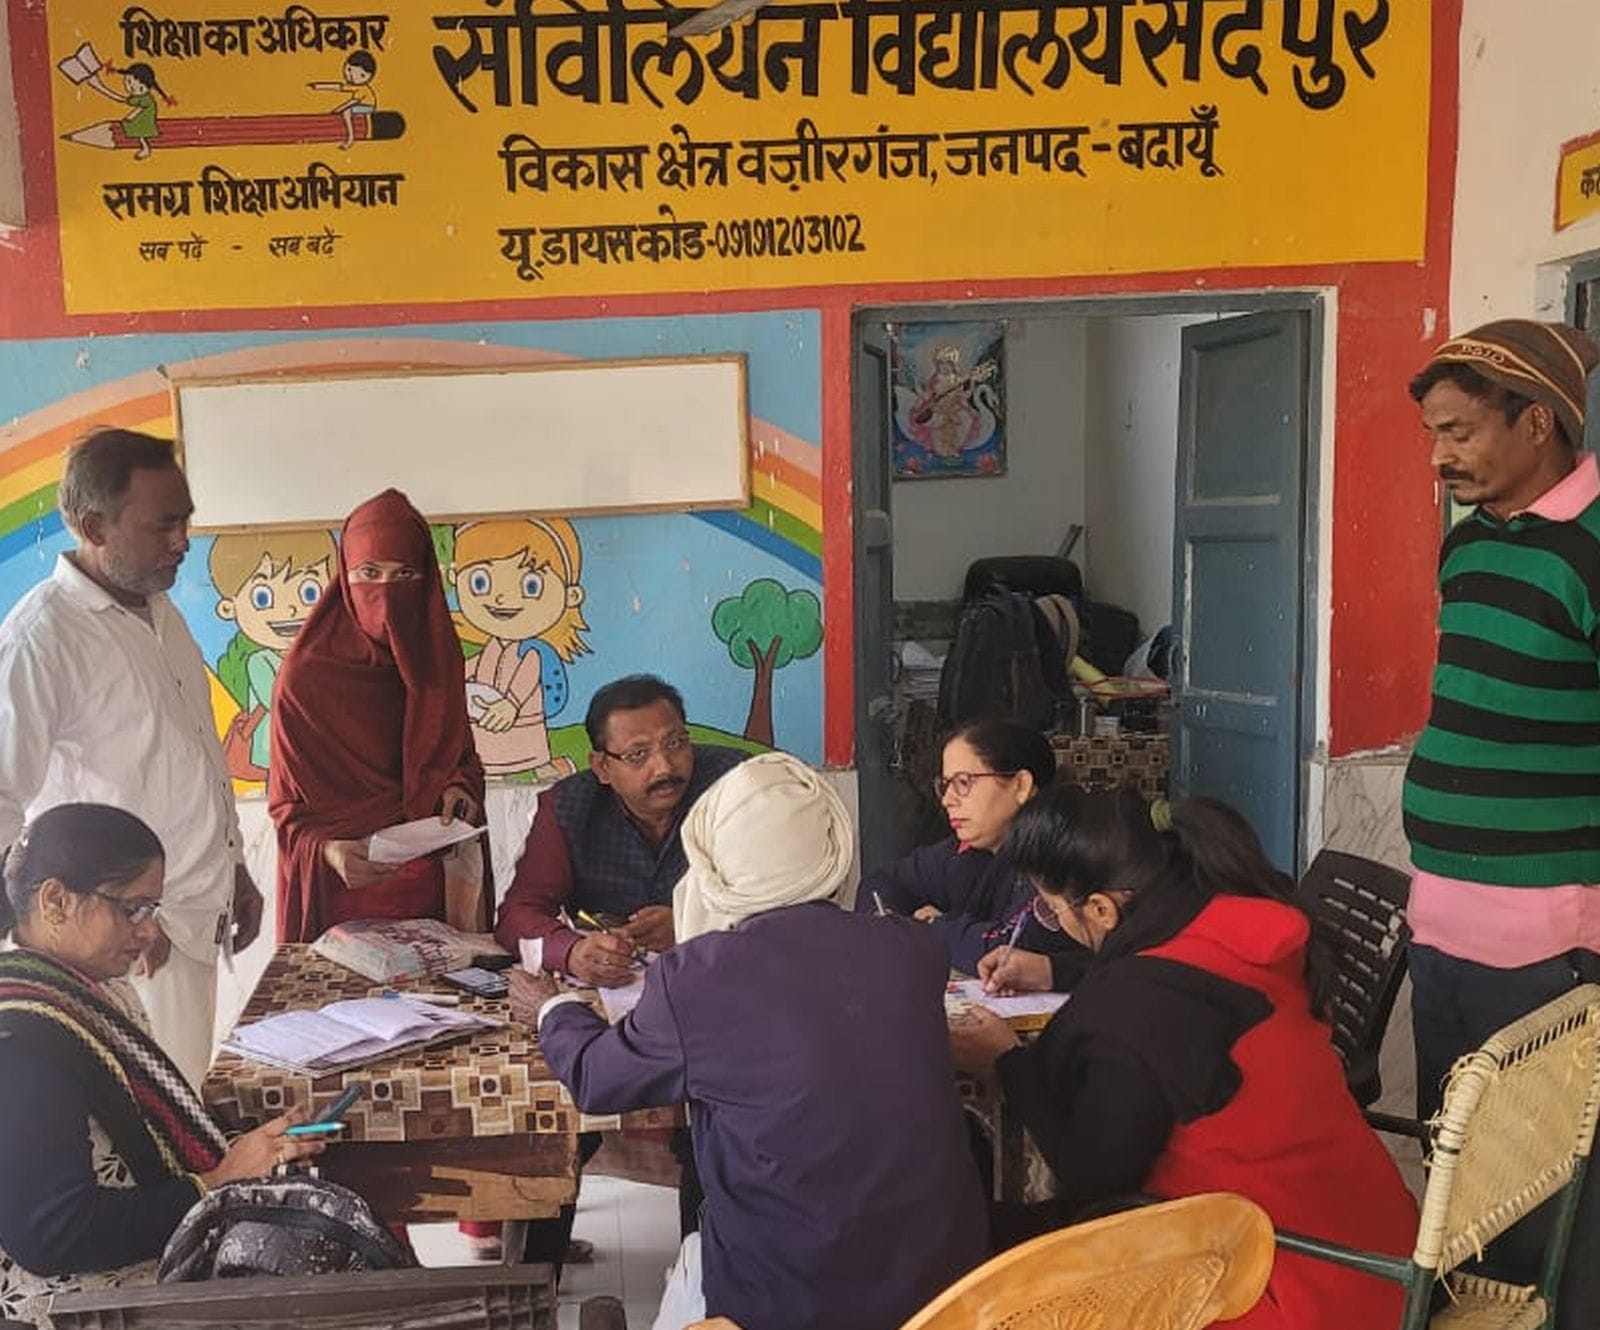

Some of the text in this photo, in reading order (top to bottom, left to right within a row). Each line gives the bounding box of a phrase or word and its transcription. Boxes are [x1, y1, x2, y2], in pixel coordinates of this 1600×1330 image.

[203, 19, 254, 56] का
[255, 5, 390, 55] अधिकार
[499, 133, 650, 193] विकास
[655, 123, 733, 192] क्षेत्र
[943, 126, 1091, 179] जनपद
[1116, 103, 1225, 179] बदायूँ
[102, 181, 195, 221] समग्र
[280, 162, 405, 211] अभियान
[139, 240, 173, 263] सब
[268, 234, 305, 258] सब
